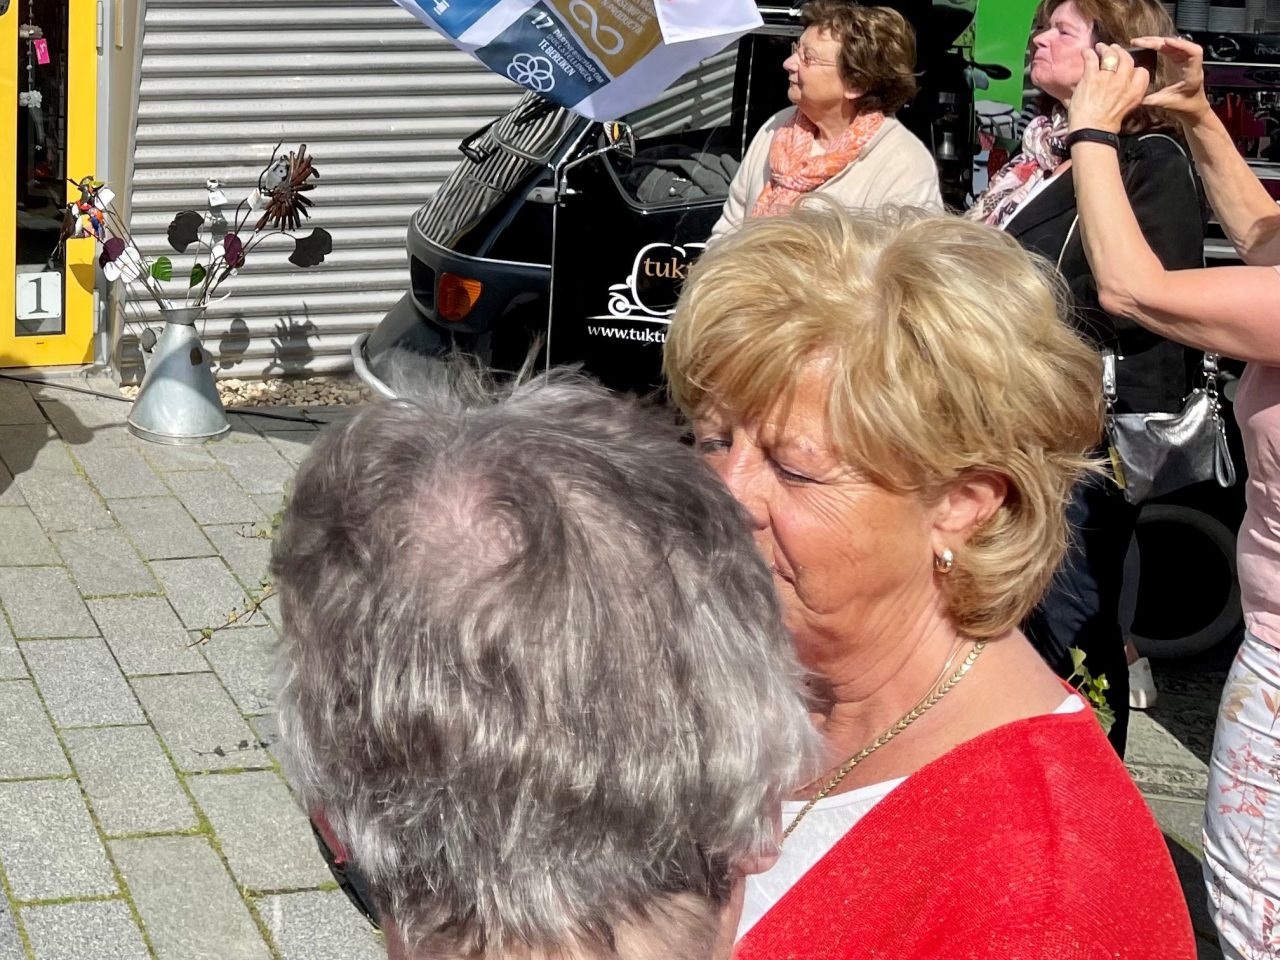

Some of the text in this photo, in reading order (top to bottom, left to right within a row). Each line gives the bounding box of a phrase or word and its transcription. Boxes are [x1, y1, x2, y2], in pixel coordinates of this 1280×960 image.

[531, 11, 554, 29] 17
[538, 38, 576, 77] TE BEREIKEN
[28, 277, 49, 314] 1
